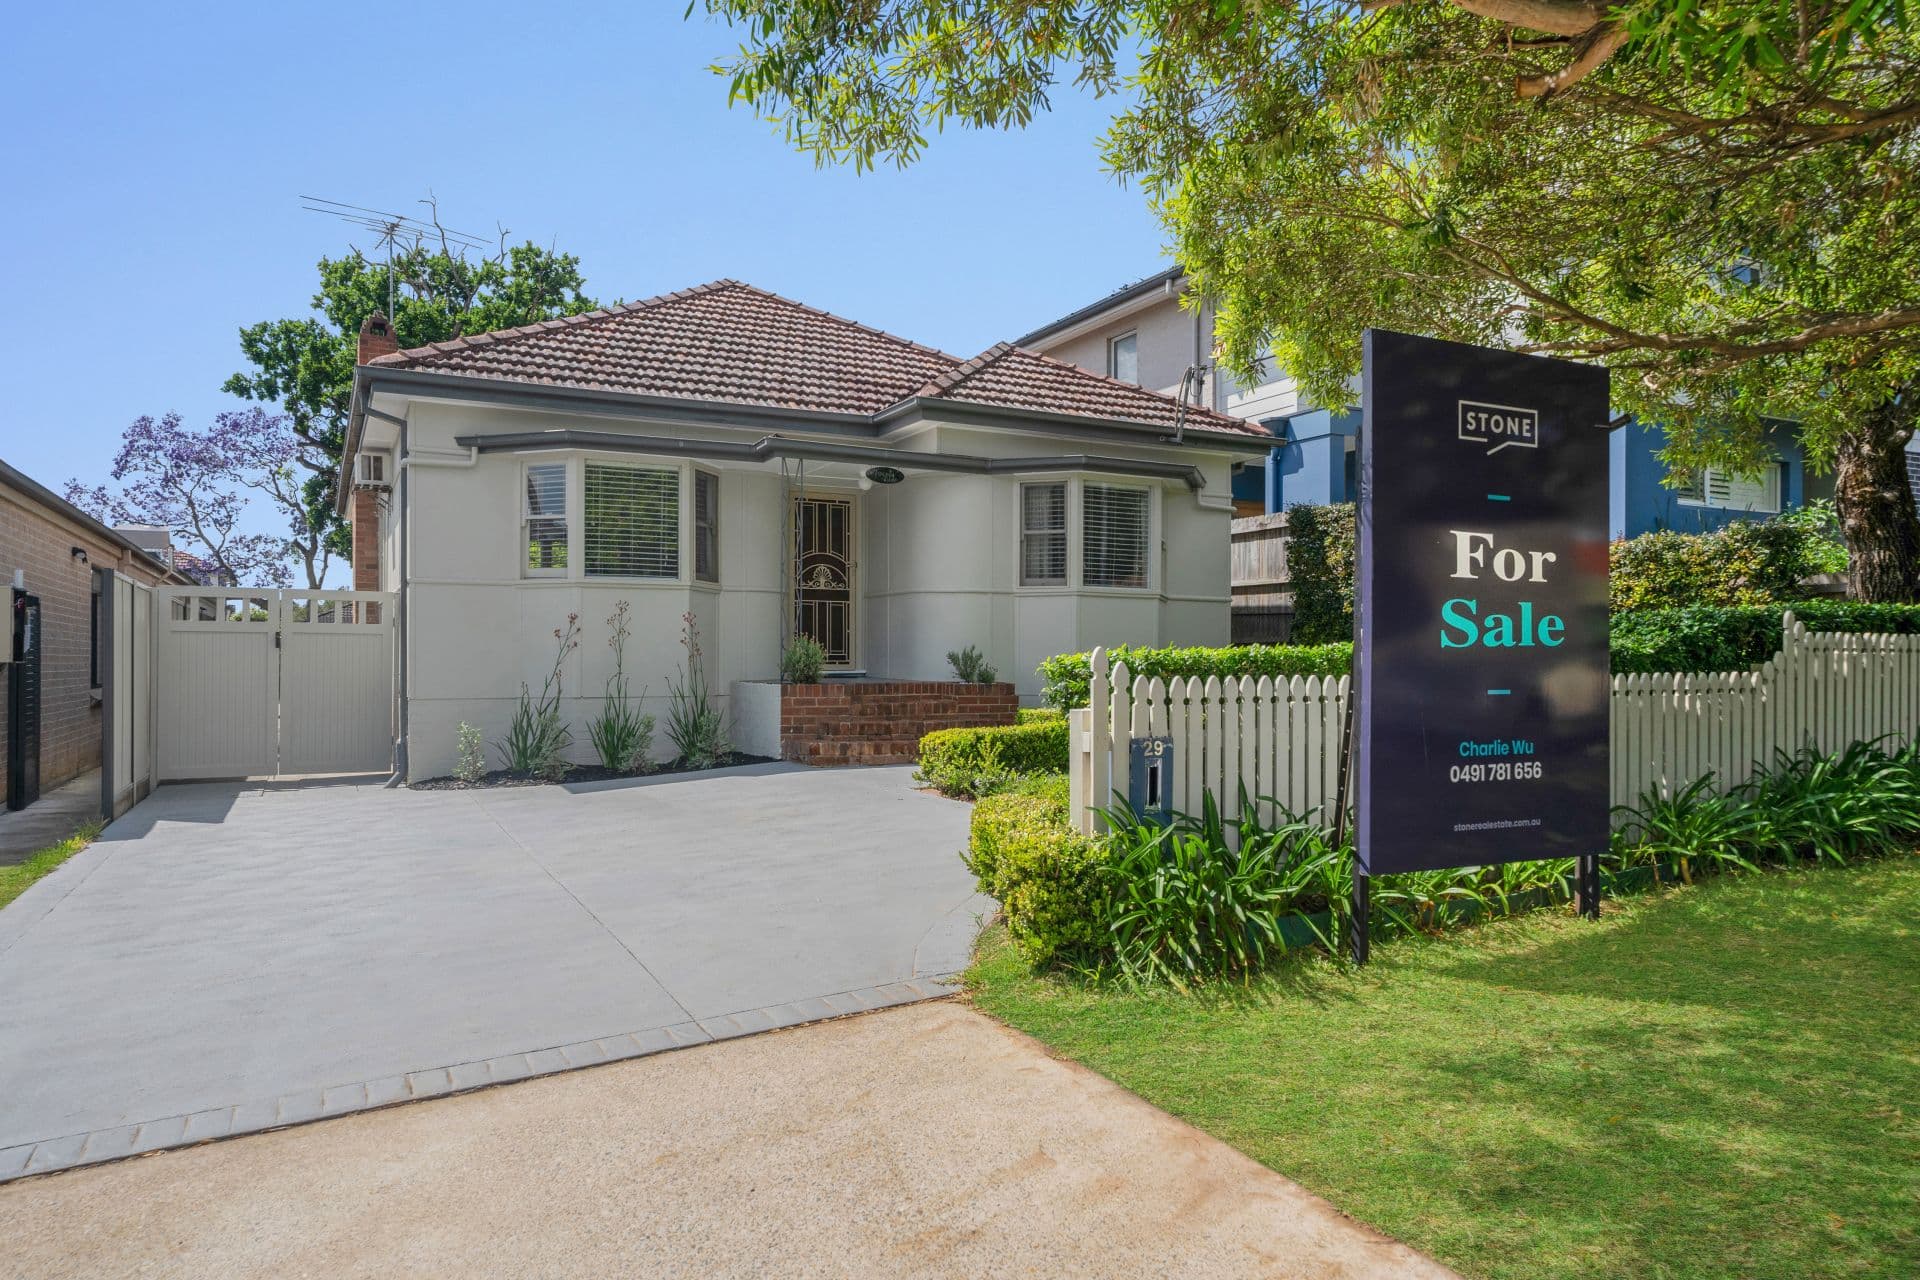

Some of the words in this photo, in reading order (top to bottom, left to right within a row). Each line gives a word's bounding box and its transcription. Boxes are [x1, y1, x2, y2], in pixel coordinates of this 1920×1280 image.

[1466, 411, 1532, 438] STONE
[1449, 530, 1557, 583] For
[1440, 598, 1565, 649] Sale
[1143, 740, 1163, 756] 29
[1459, 739, 1510, 757] Charlie
[1511, 740, 1534, 755] Wu
[1450, 764, 1485, 783] 0491
[1487, 762, 1511, 781] 781
[1514, 761, 1542, 780] 656
[1453, 818, 1542, 832] stonerealestate.com.au
